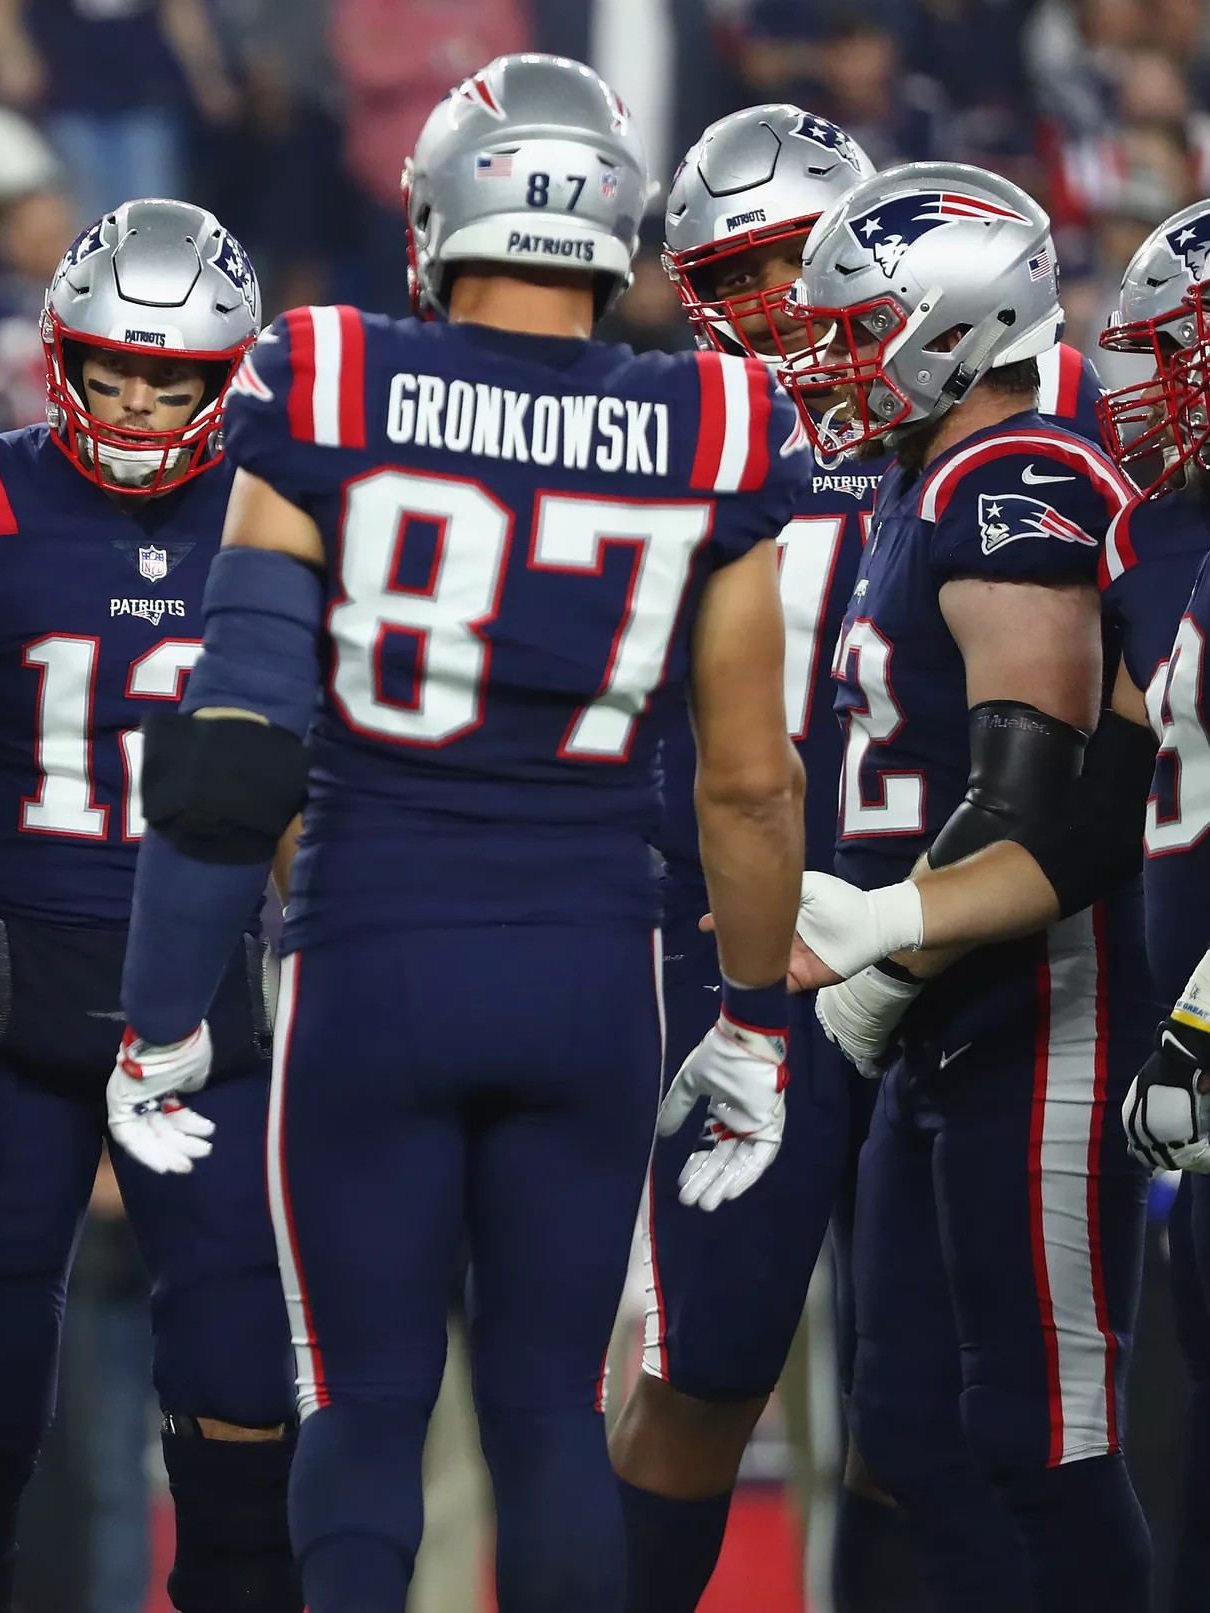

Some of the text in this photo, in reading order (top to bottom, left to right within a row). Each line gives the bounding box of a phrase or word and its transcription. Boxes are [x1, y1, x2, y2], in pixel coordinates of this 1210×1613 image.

[526, 172, 587, 213] 87
[726, 208, 767, 232] PATRIOTS
[507, 231, 595, 262] PATRIOTS
[124, 329, 166, 347] PATRIOTS
[387, 372, 669, 476] GRONKOWSKI
[812, 475, 884, 494] PATRIOT
[109, 598, 186, 618] PATRIOTS
[326, 464, 716, 762] 87
